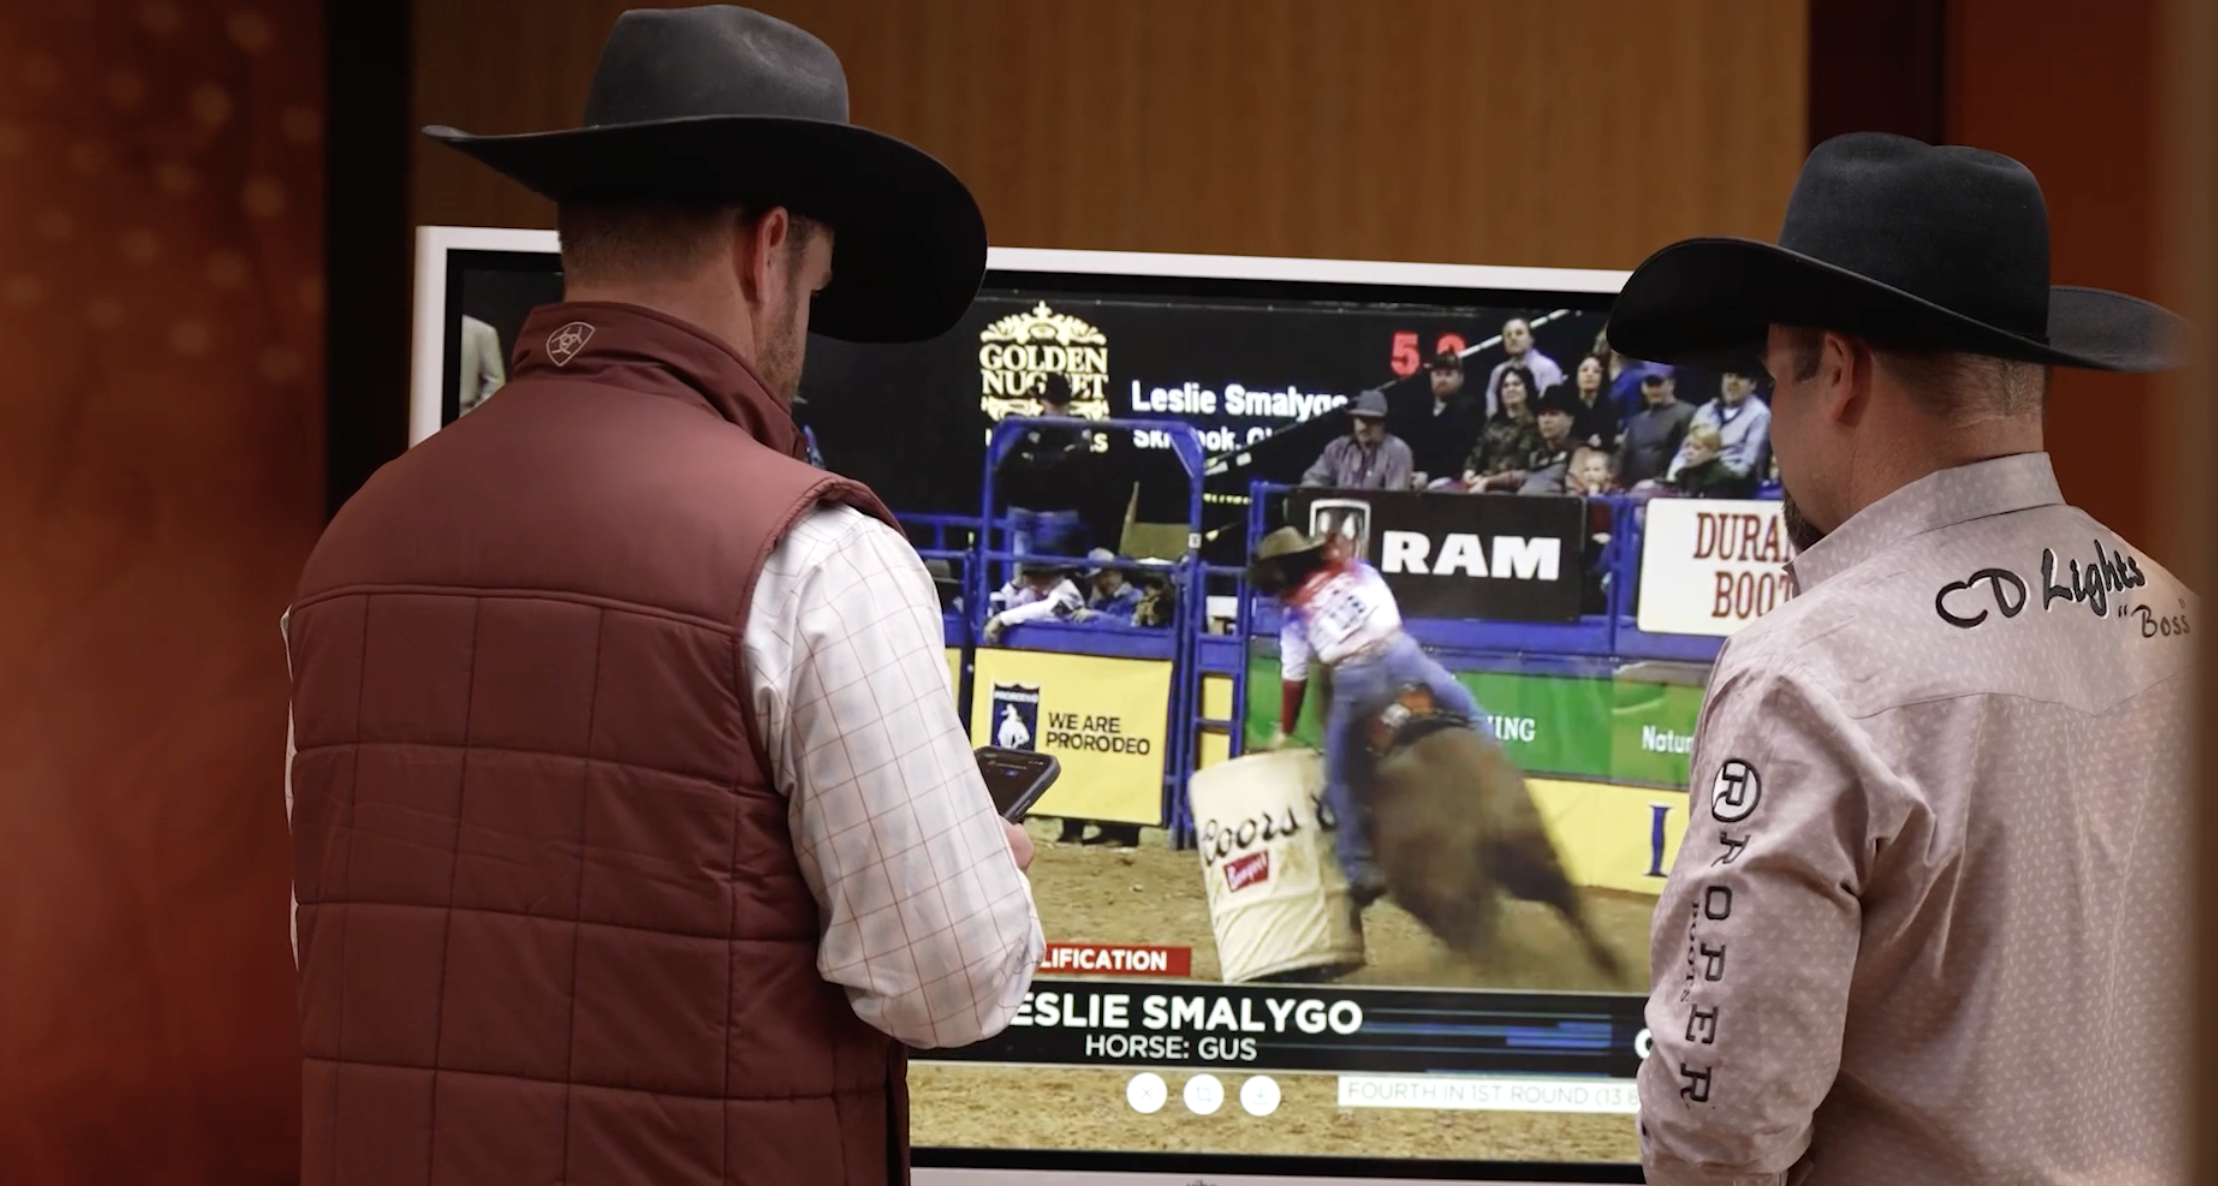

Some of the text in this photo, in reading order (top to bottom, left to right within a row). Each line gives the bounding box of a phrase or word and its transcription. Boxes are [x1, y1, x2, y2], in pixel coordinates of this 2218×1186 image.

[979, 343, 1108, 373] GOLDEN
[980, 368, 1109, 399] NUGET
[1131, 379, 1217, 414] Leslie
[1381, 530, 1561, 581] RAM
[1935, 539, 2147, 629] CD Lights
[1048, 712, 1121, 734] WE ARE
[1487, 715, 1536, 742] ING
[1046, 731, 1151, 756] PRORODEO
[1680, 831, 1751, 1108] ROPER
[1142, 995, 1364, 1035] SMALYGO
[1085, 1034, 1258, 1061] HORSE: GUS
[1348, 1081, 1437, 1101] FOURTH
[1443, 1084, 1465, 1101] IN
[1471, 1084, 1503, 1103] 1ST
[1510, 1085, 1590, 1104] ROUND
